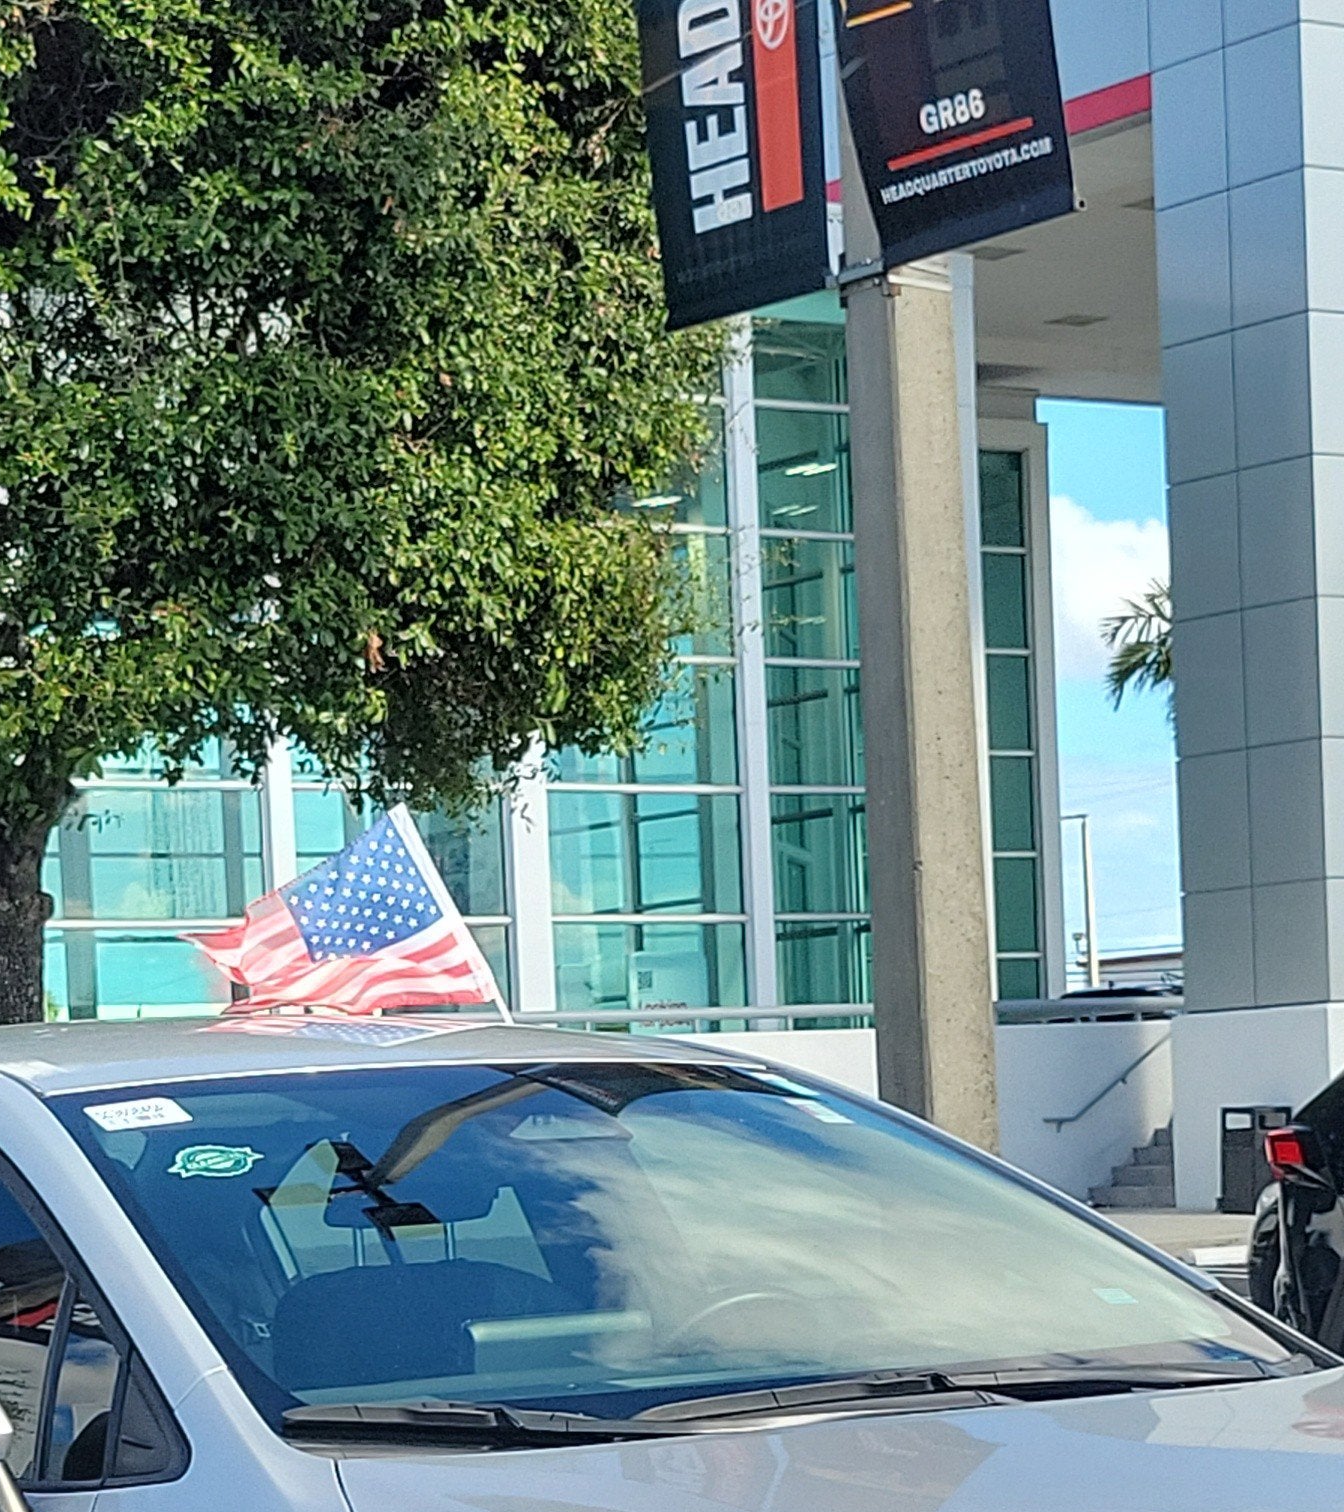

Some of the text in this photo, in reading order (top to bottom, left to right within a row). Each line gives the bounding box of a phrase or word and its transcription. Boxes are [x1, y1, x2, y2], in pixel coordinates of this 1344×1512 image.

[677, 0, 754, 234] HEAD
[919, 89, 986, 134] GR86
[880, 137, 1053, 204] HEADQUARTERTOYOTA.COM
